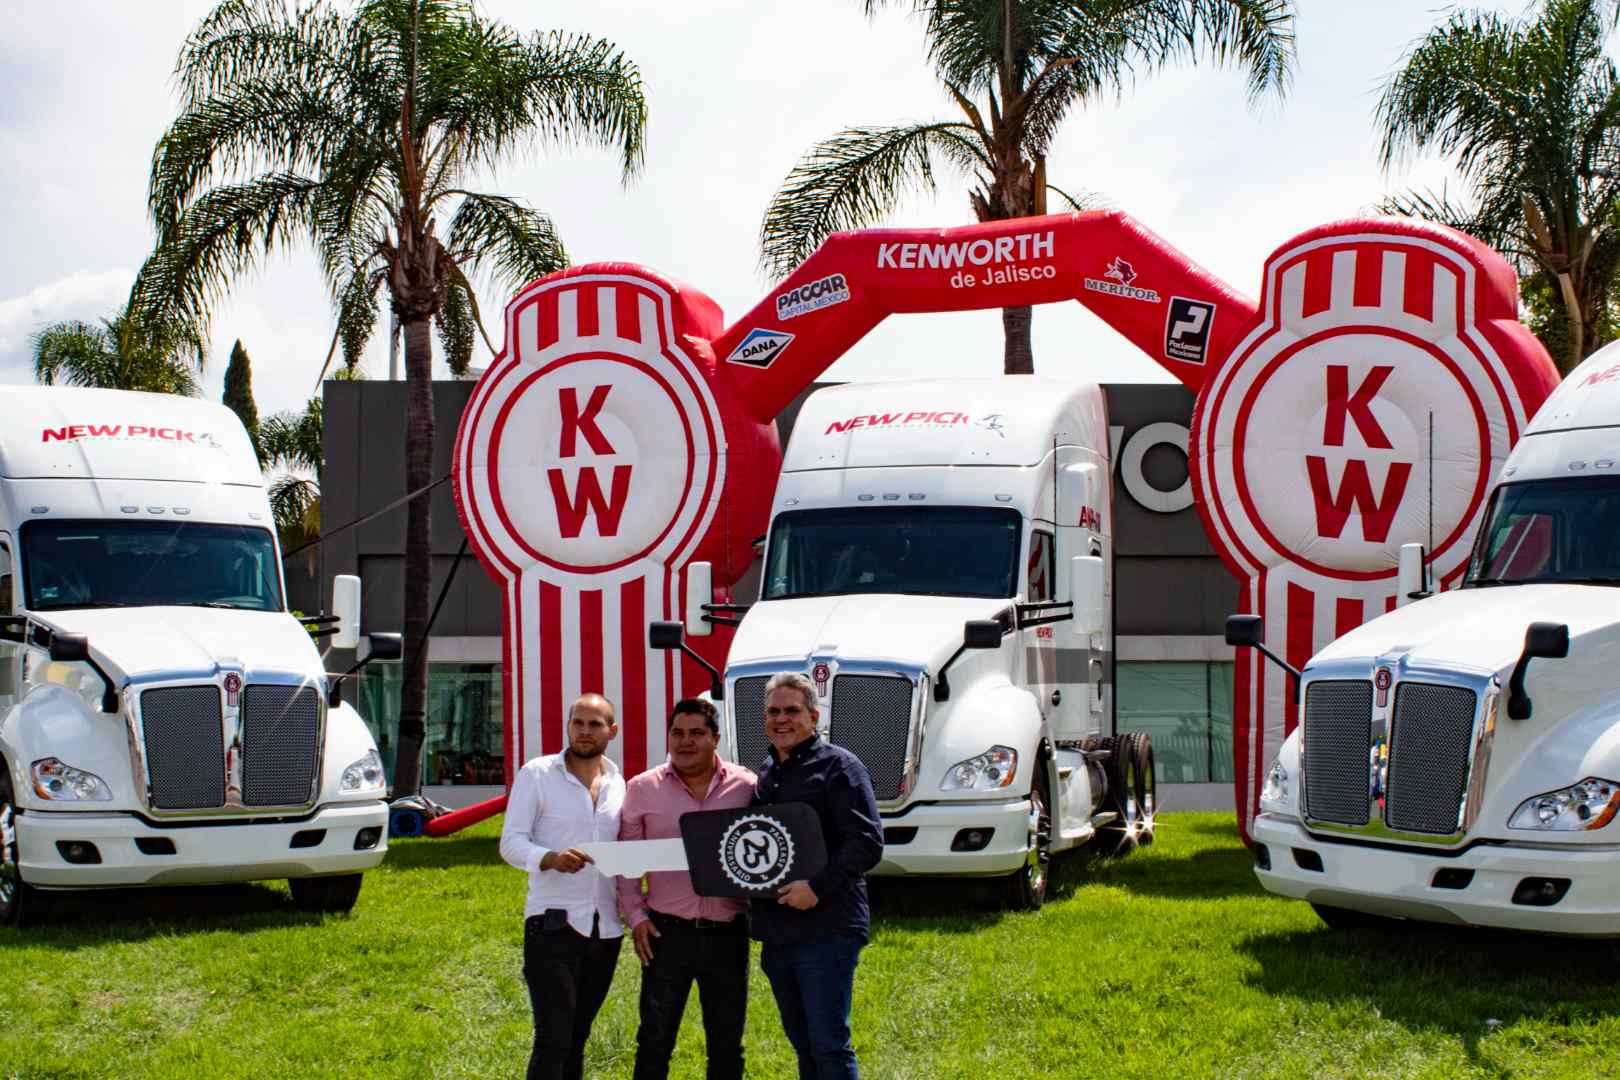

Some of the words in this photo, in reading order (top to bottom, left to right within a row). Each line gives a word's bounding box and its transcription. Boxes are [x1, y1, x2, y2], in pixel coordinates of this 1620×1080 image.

[877, 231, 1055, 269] KENWORTH
[950, 271, 976, 288] de
[982, 265, 1056, 286] Jalisco
[778, 275, 847, 309] PACCAR
[1085, 279, 1157, 300] MERITOR
[742, 339, 778, 358] DANA
[42, 424, 122, 442] NEW
[127, 425, 197, 444] PICK
[823, 412, 904, 435] NEW
[726, 829, 751, 880] ANIVERSARIO
[743, 835, 770, 868] 25
